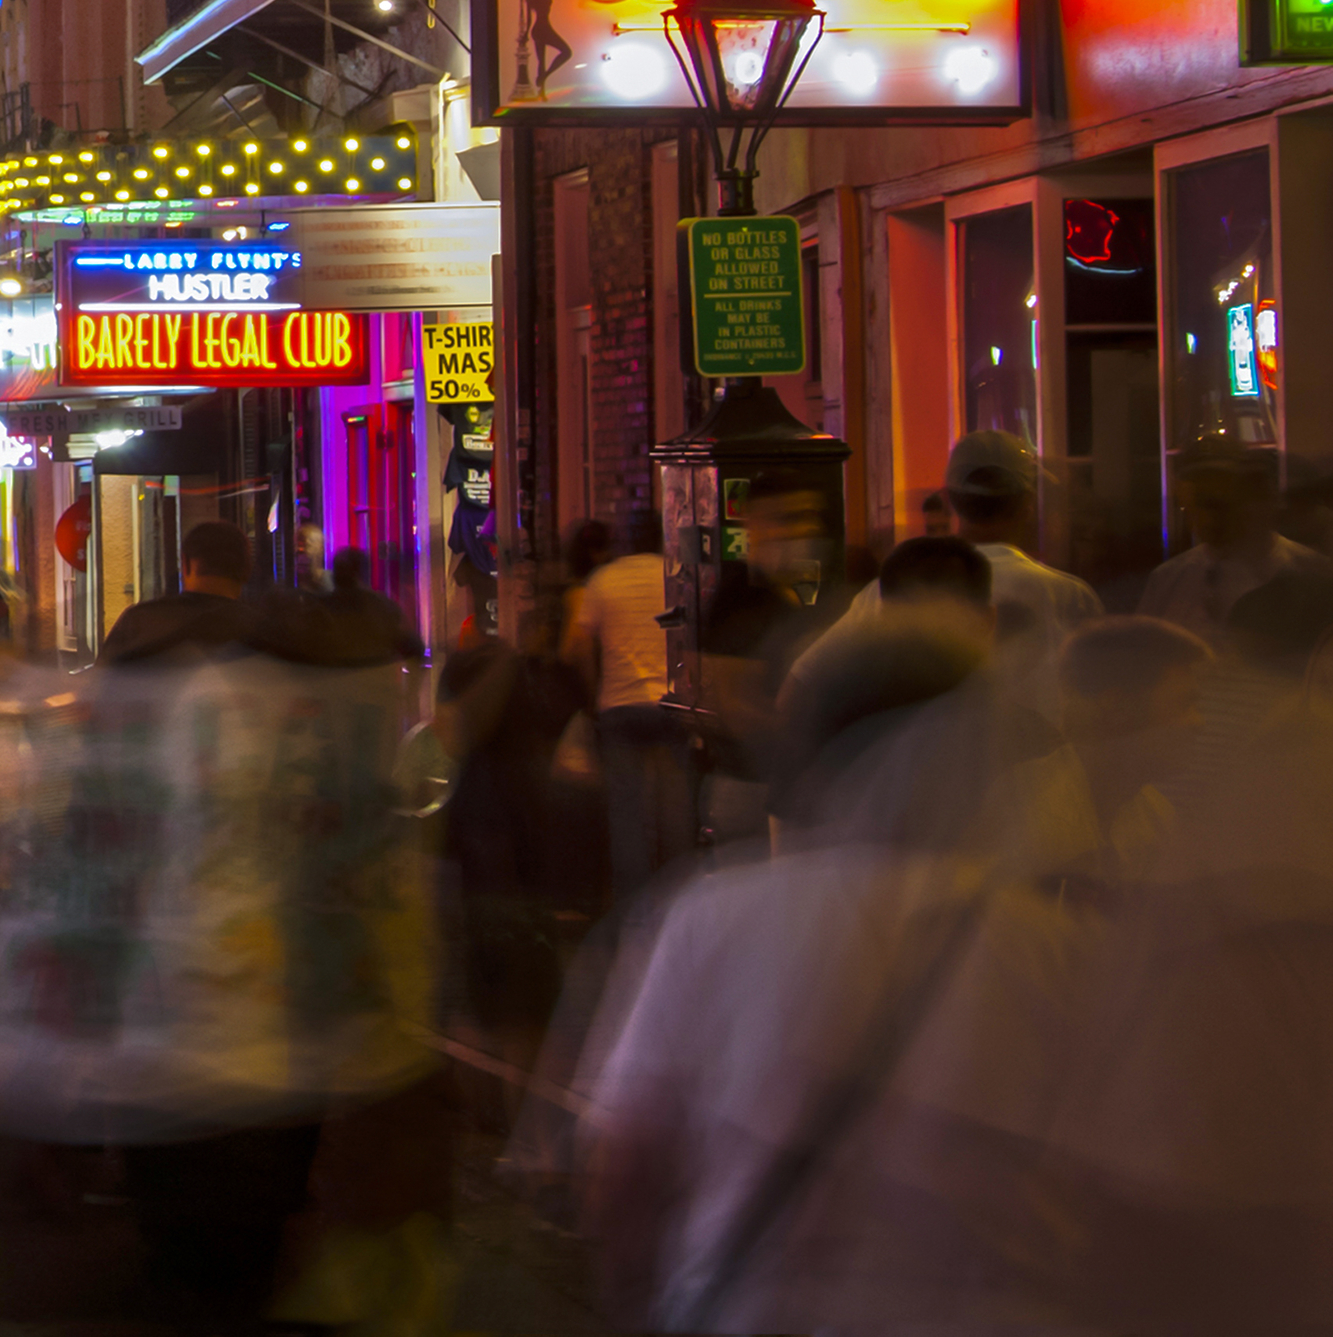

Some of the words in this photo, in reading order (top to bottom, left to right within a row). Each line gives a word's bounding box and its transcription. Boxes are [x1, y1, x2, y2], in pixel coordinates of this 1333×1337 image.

[703, 233, 721, 245] NO
[727, 231, 787, 245] BOTTLES
[711, 248, 729, 260] OR
[735, 246, 780, 260] GLASS
[124, 253, 198, 270] LARRY
[211, 252, 302, 270] FLYNT'S
[715, 261, 779, 275] ALLOWED
[149, 273, 270, 301] HUSTLER
[709, 278, 728, 290] ON
[734, 276, 785, 289] STREET
[715, 301, 734, 312] ALL
[739, 299, 782, 310] DRINKS
[727, 313, 751, 324] MAY
[756, 312, 770, 323] BE
[424, 325, 493, 349] T-SHIR
[719, 327, 730, 337] IN
[735, 325, 781, 336] PLASTIC
[77, 314, 181, 369] BARELY
[192, 312, 277, 369] LEGAL
[284, 312, 352, 368] CLUB
[715, 338, 785, 350] CONTAINERS
[430, 379, 481, 400] 50%
[8, 416, 68, 434] FRESH
[124, 409, 178, 427] GRILL
